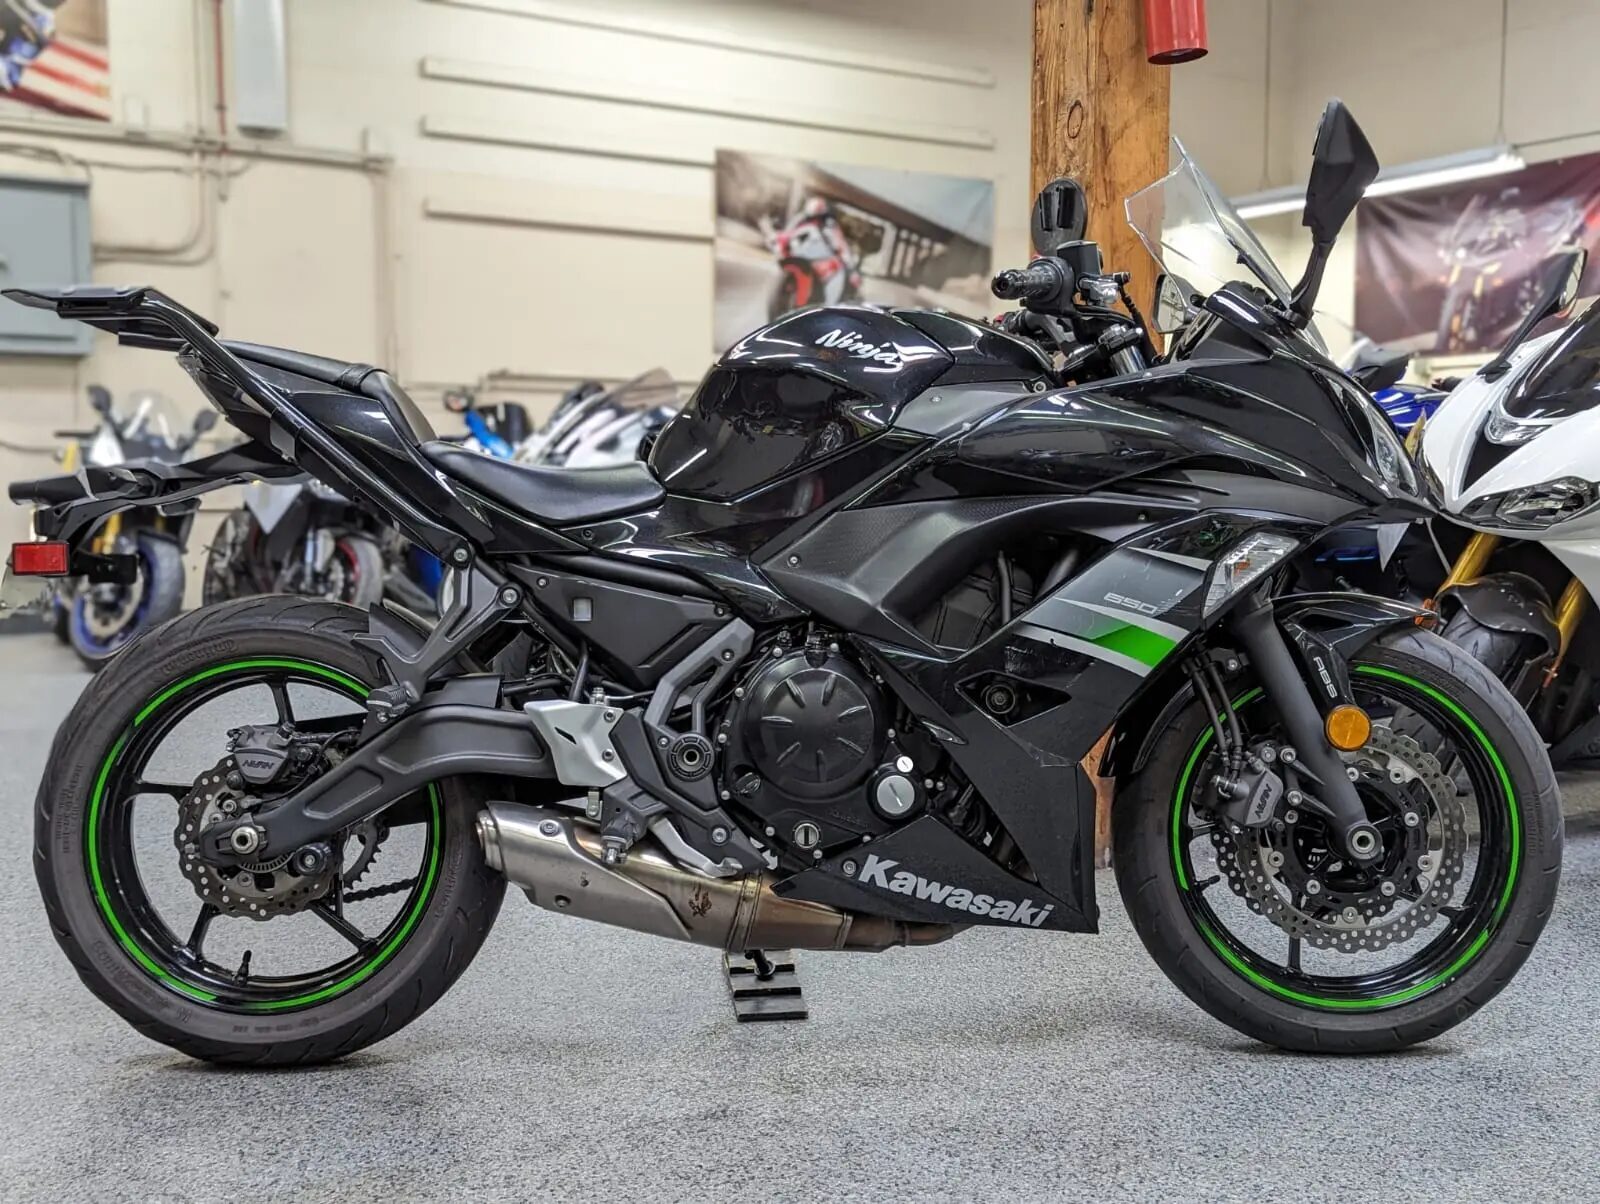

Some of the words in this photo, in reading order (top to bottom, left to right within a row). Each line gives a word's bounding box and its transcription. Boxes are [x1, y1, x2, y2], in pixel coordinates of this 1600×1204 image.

[815, 329, 904, 372] Ninja
[1104, 592, 1158, 614] 650
[1313, 656, 1338, 699] ABS
[858, 854, 1055, 927] Kawasaki
